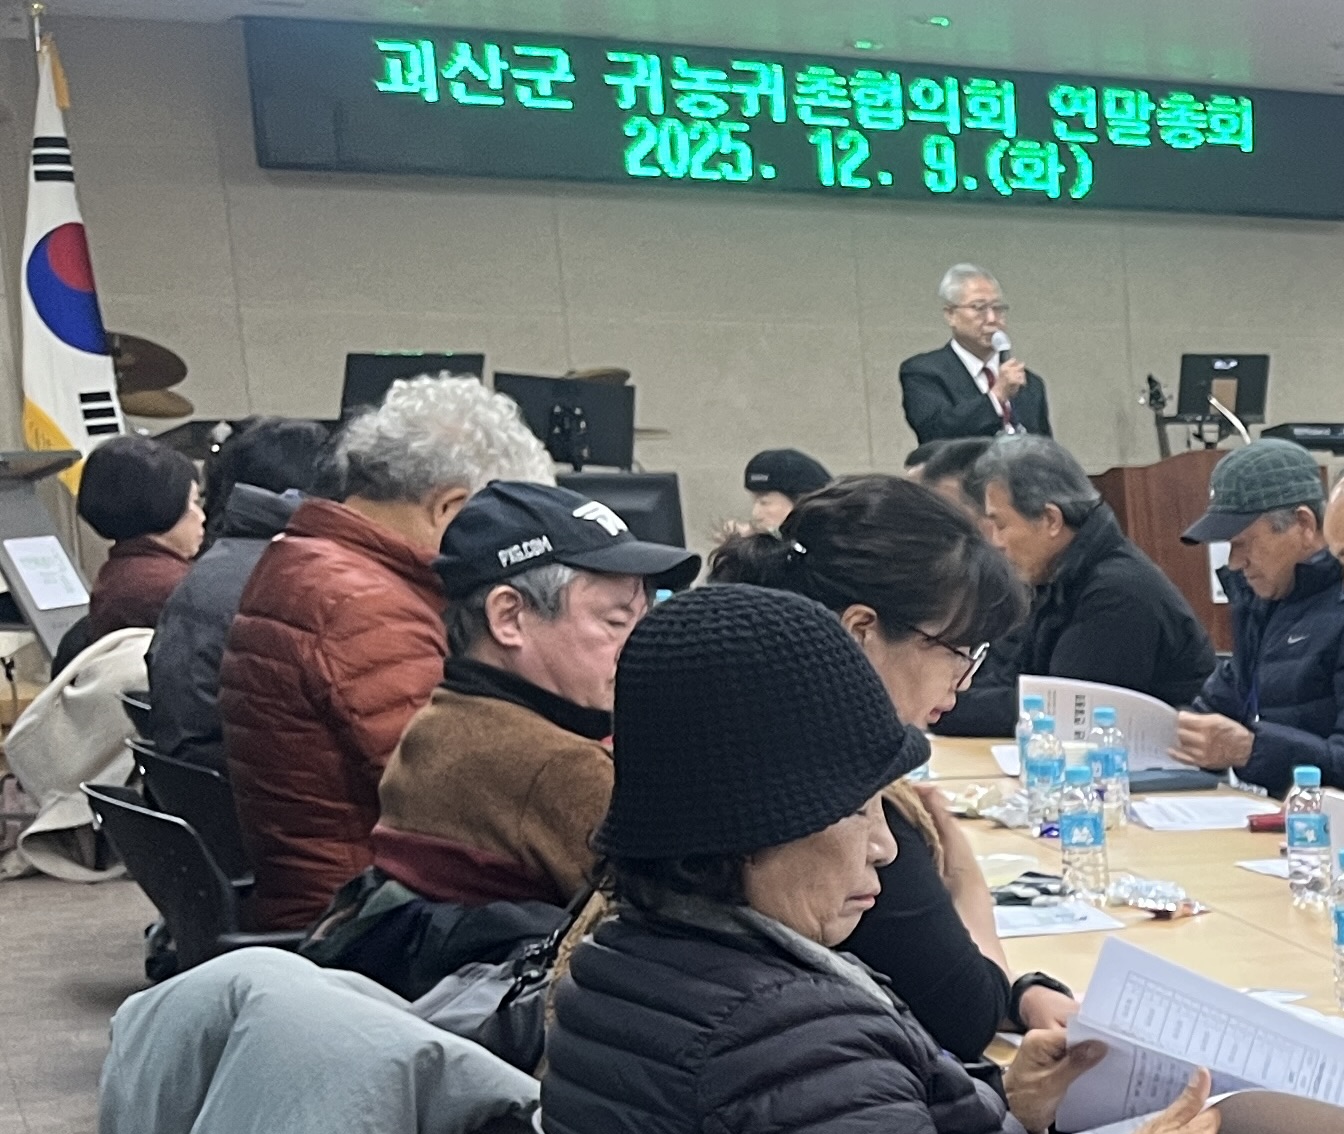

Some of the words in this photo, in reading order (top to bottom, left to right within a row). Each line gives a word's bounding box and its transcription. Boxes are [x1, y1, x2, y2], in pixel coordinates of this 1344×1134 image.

[374, 39, 576, 110] 괴산군
[603, 50, 1016, 138] 귀농귀촌협의회
[1048, 83, 1254, 153] 연말총회
[623, 115, 776, 182] 2025.
[808, 127, 893, 189] 12.
[922, 133, 1093, 200] 9.(화)
